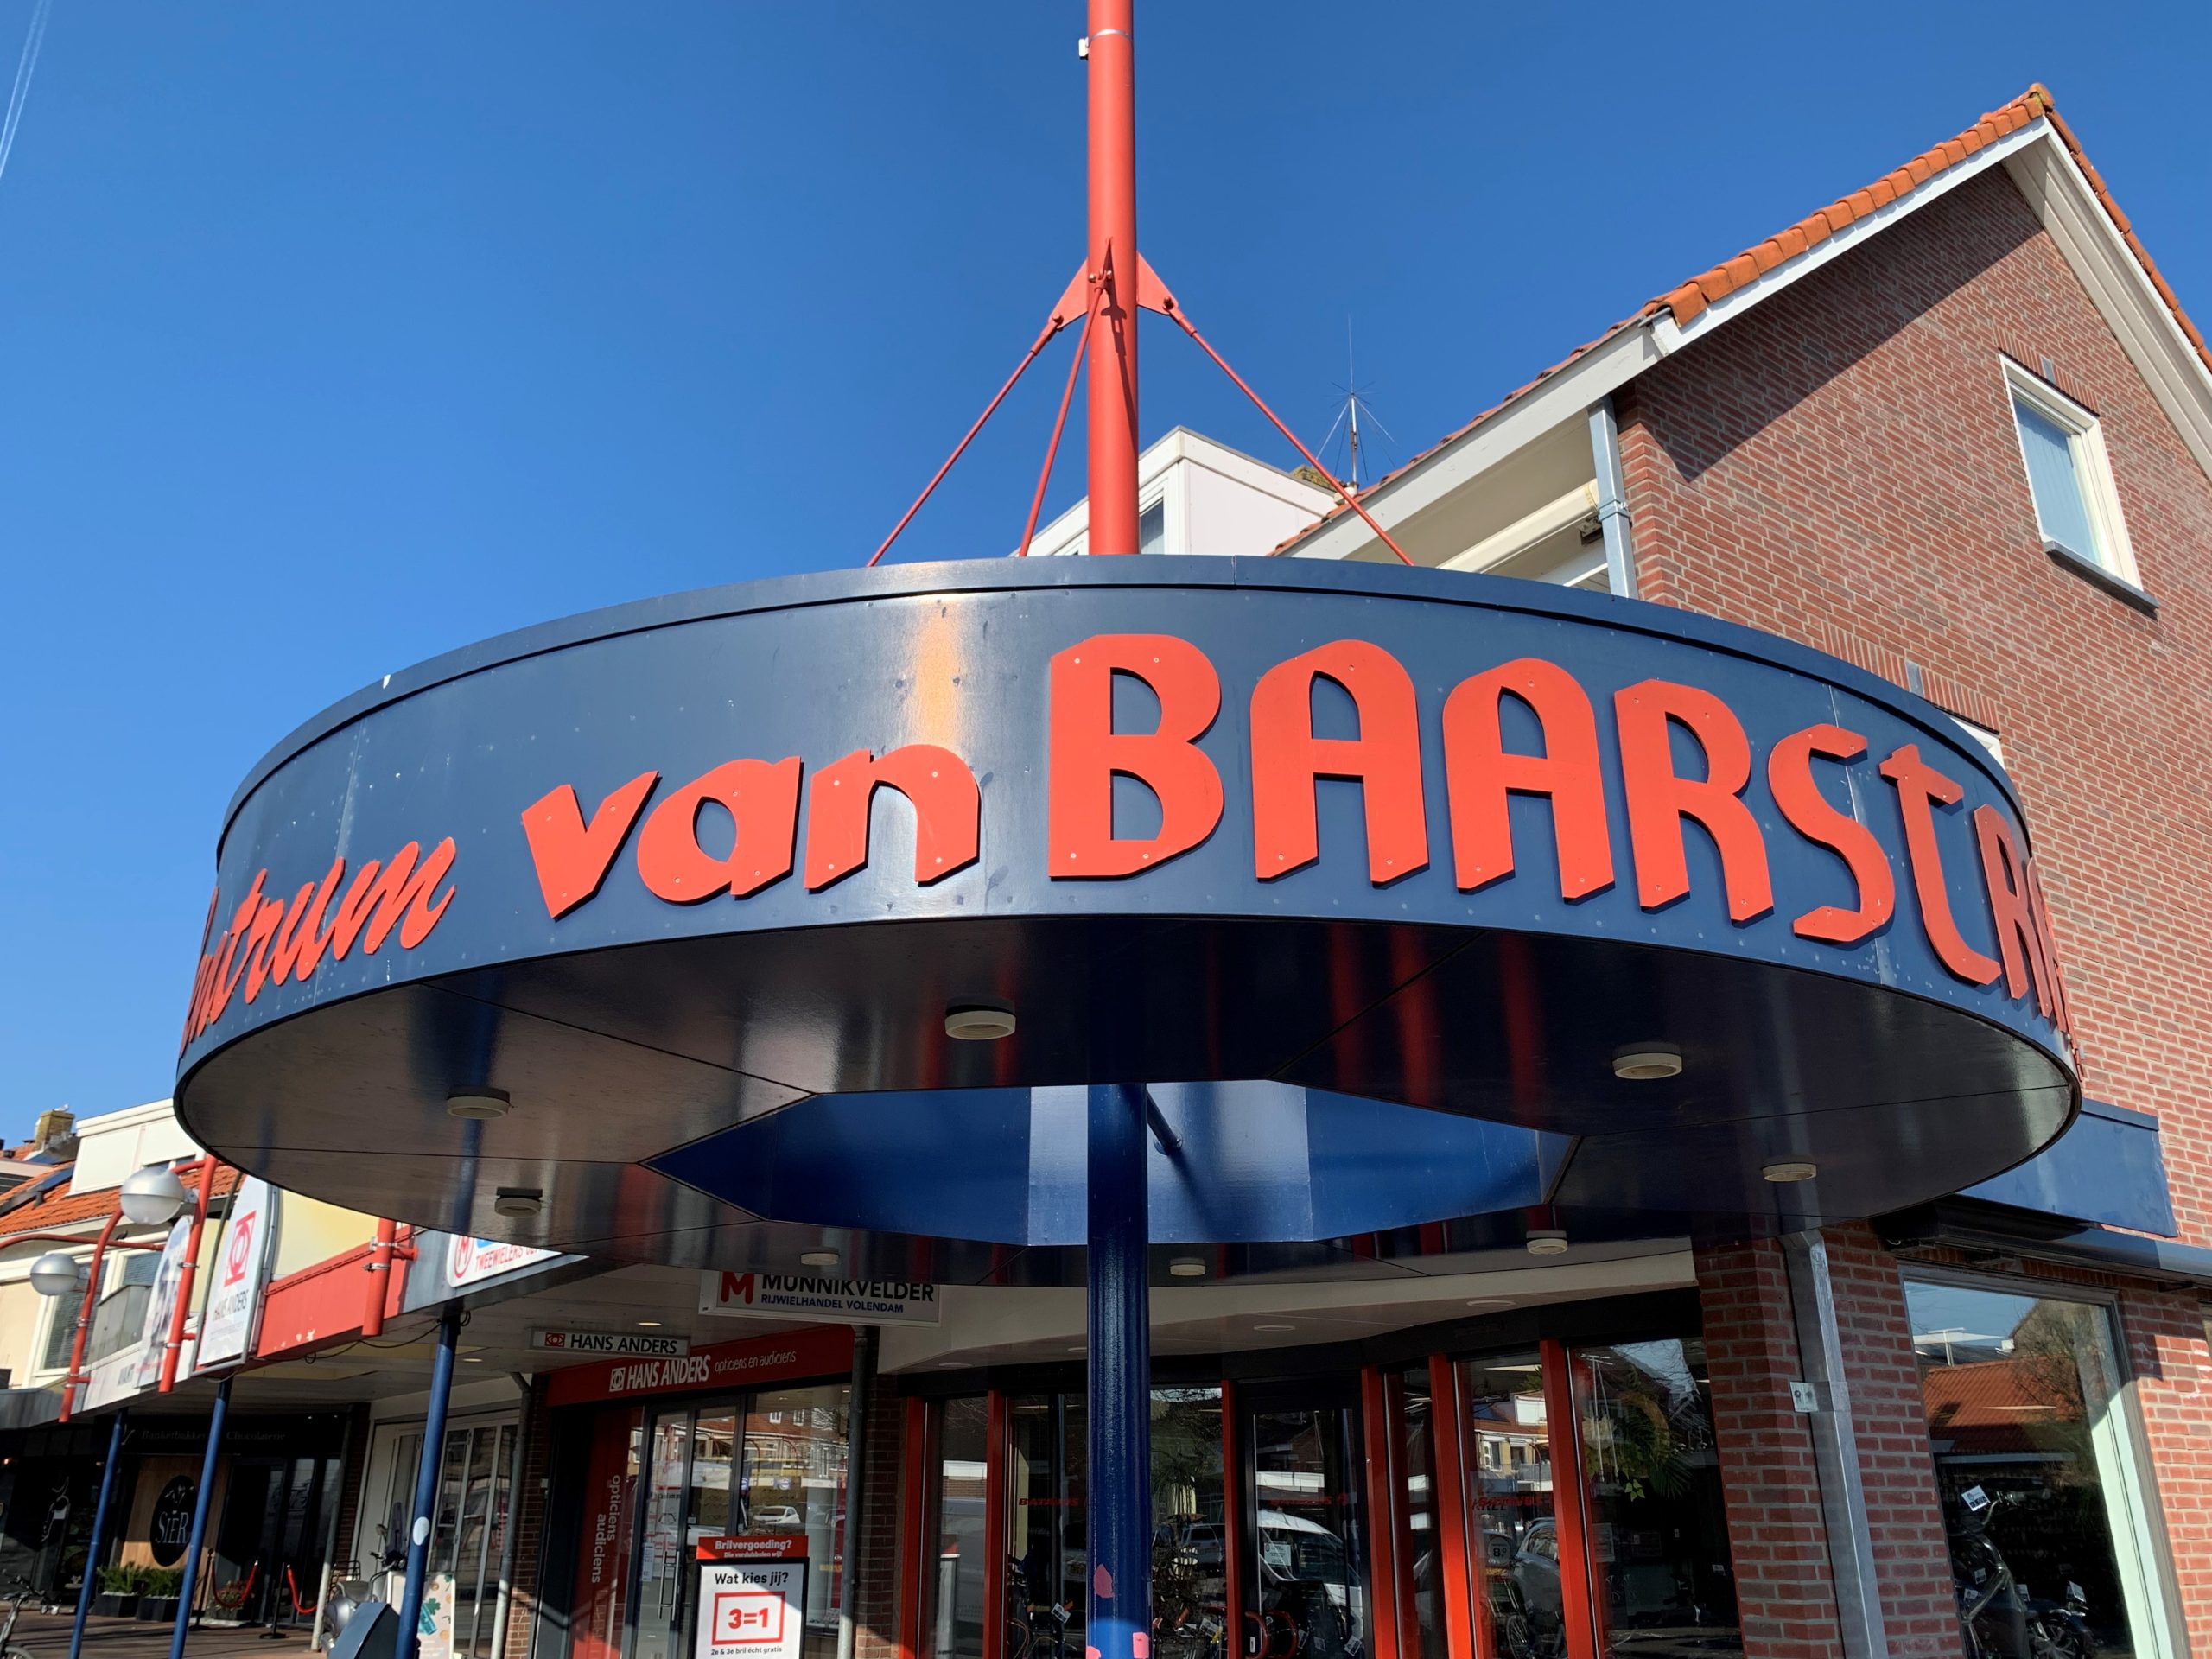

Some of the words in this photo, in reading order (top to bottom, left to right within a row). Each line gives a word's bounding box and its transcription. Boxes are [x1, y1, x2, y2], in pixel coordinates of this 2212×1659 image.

[522, 744, 979, 918] van
[762, 1274, 935, 1302] MUNNIKVELDER
[761, 1294, 843, 1309] RIJWIELHANDEL
[847, 1300, 904, 1313] VOLENDAM
[570, 1335, 613, 1351] HANS
[617, 1338, 677, 1355] ANDERS
[626, 1361, 660, 1389] HANS
[661, 1355, 711, 1387] ANDERS
[715, 1357, 747, 1376] opticiens
[747, 1355, 759, 1368] en
[760, 1350, 797, 1367] audiciens
[607, 1474, 622, 1541] opticiens
[155, 1510, 191, 1544] SIER
[592, 1513, 607, 1584] audiciens
[715, 1539, 792, 1552] Brilvergoeding?
[715, 1573, 740, 1585] Wat
[742, 1572, 767, 1584] kies
[769, 1571, 789, 1586] jij?
[728, 1607, 768, 1630] 3=1
[763, 1645, 782, 1655] gratis
